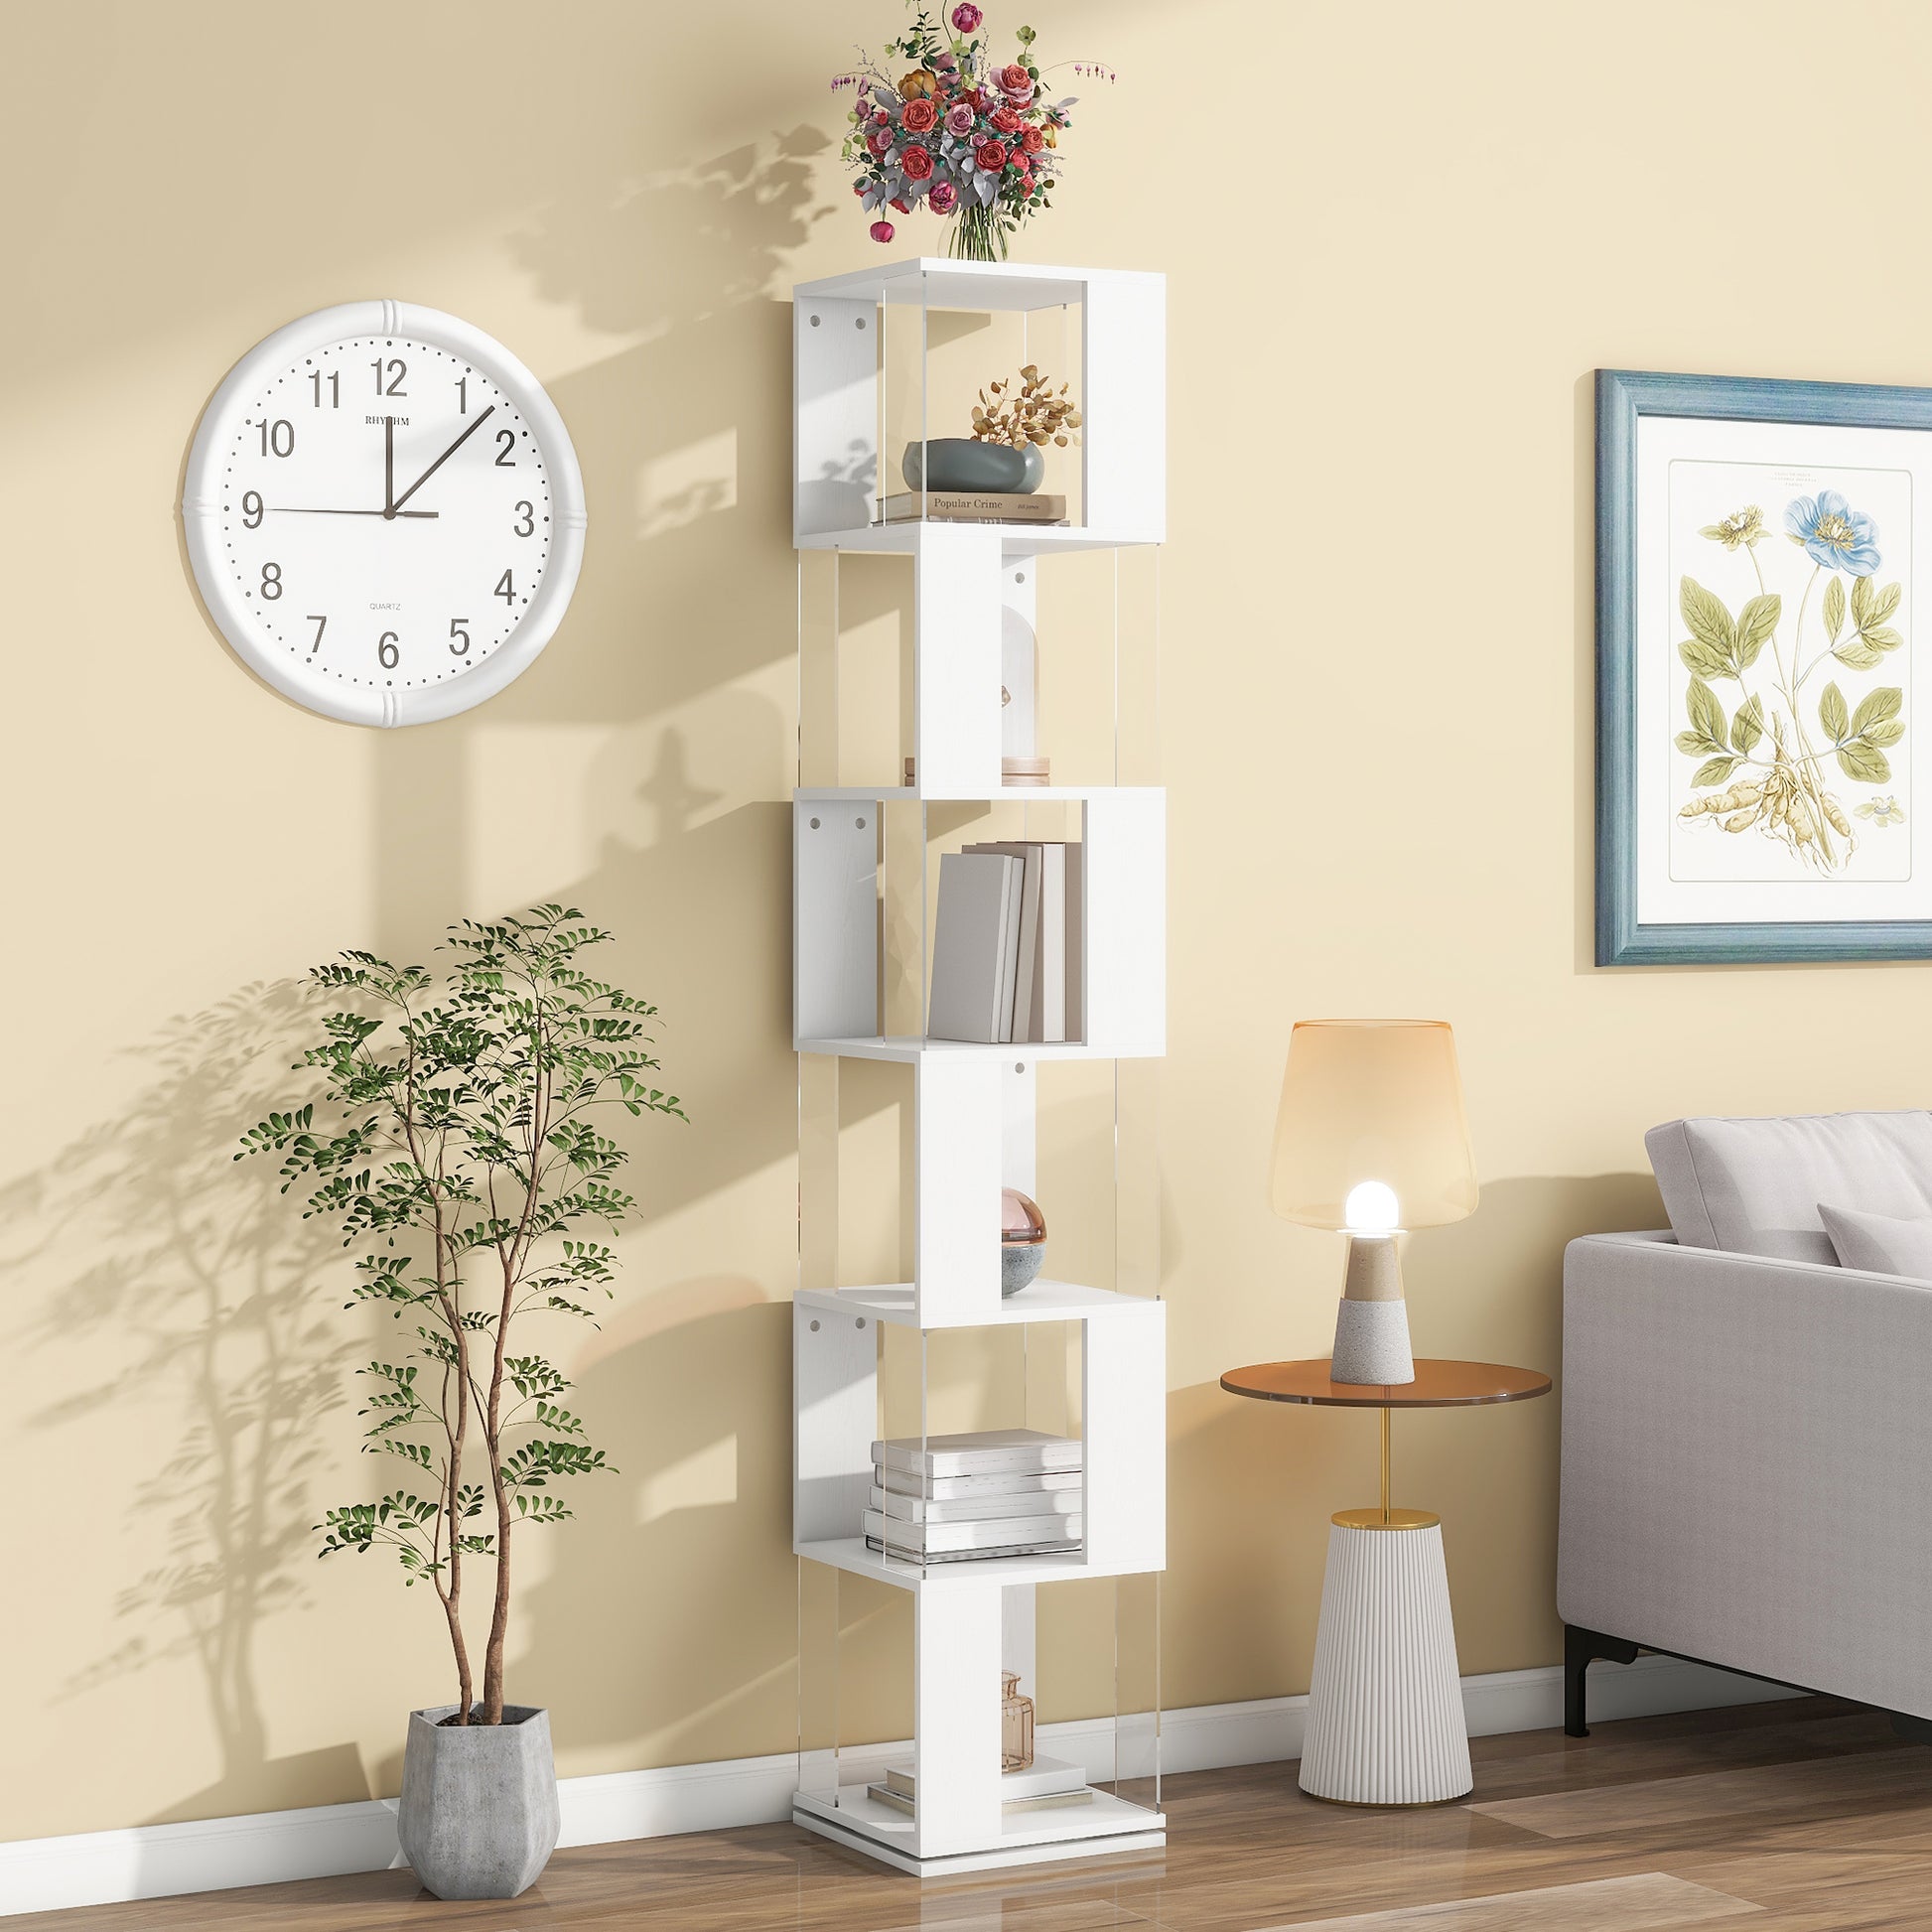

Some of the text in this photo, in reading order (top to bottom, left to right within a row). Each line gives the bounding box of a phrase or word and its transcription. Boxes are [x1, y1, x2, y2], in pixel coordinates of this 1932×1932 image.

[309, 370, 339, 408] 11
[371, 358, 407, 396] 12
[455, 377, 466, 414] 1
[256, 419, 294, 458] 10
[365, 416, 409, 426] RHYHM
[495, 430, 515, 467] 2
[242, 490, 263, 529] 9
[514, 500, 534, 537] 3
[934, 498, 971, 509] Popular
[974, 499, 1003, 508] Crime
[261, 563, 282, 600] 8
[494, 569, 516, 606] 4
[307, 616, 327, 652] 7
[378, 631, 399, 669] 6
[449, 619, 470, 655] 5
